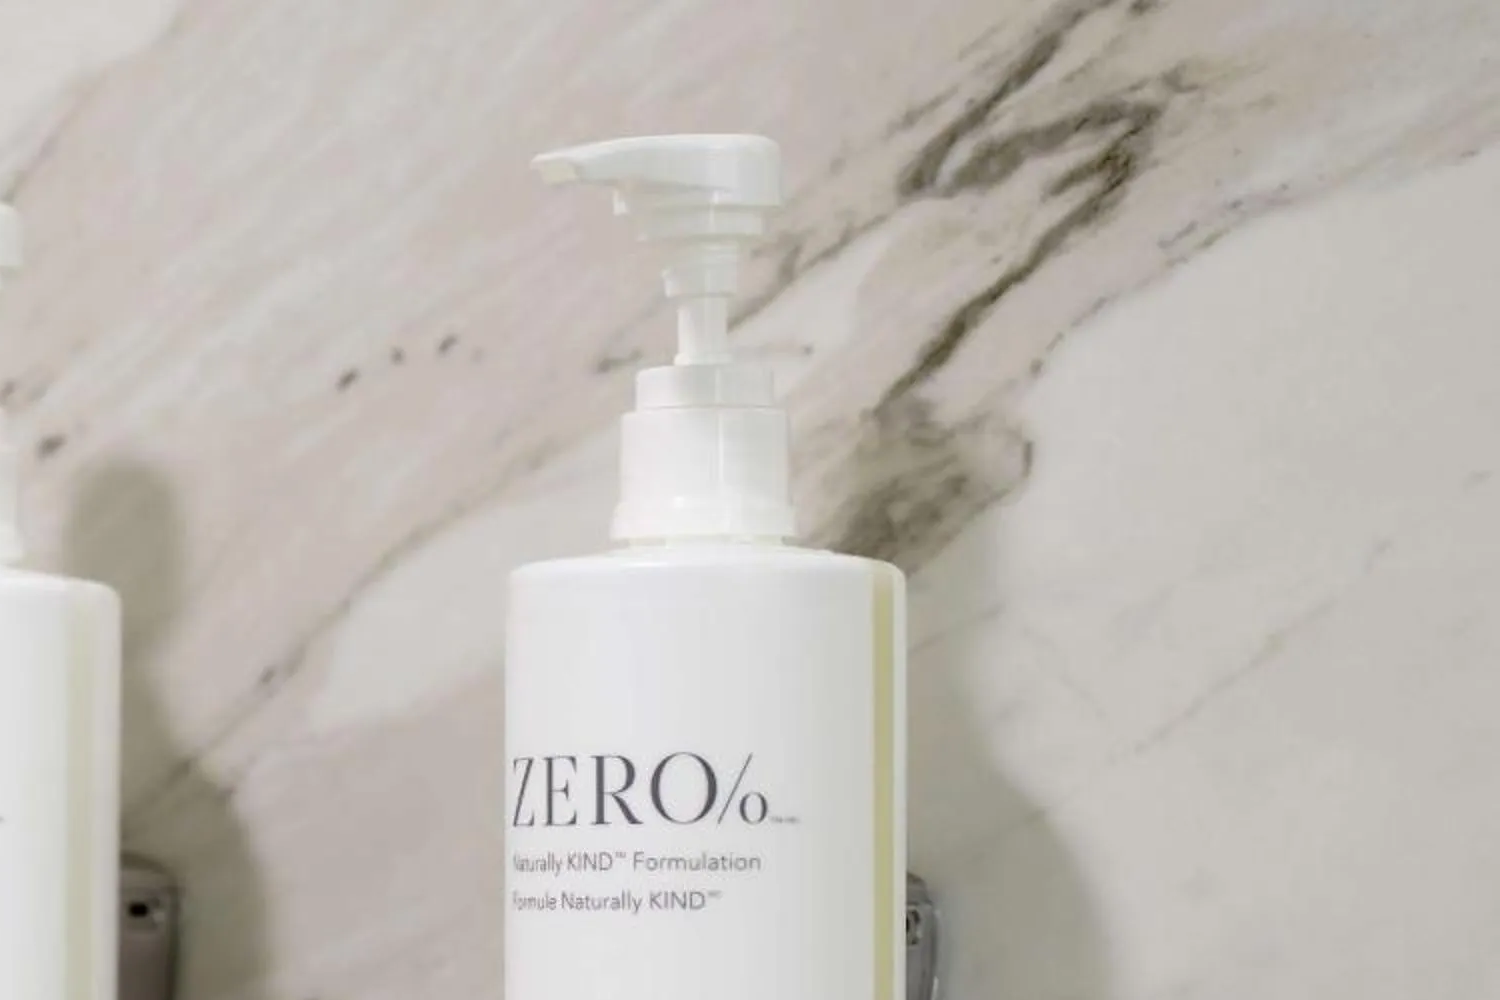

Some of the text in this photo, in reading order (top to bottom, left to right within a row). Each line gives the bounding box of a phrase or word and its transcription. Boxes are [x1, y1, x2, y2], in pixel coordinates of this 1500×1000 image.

[512, 750, 769, 828] ZERO%
[633, 851, 762, 872] Formulation
[561, 889, 642, 914] Naturally
